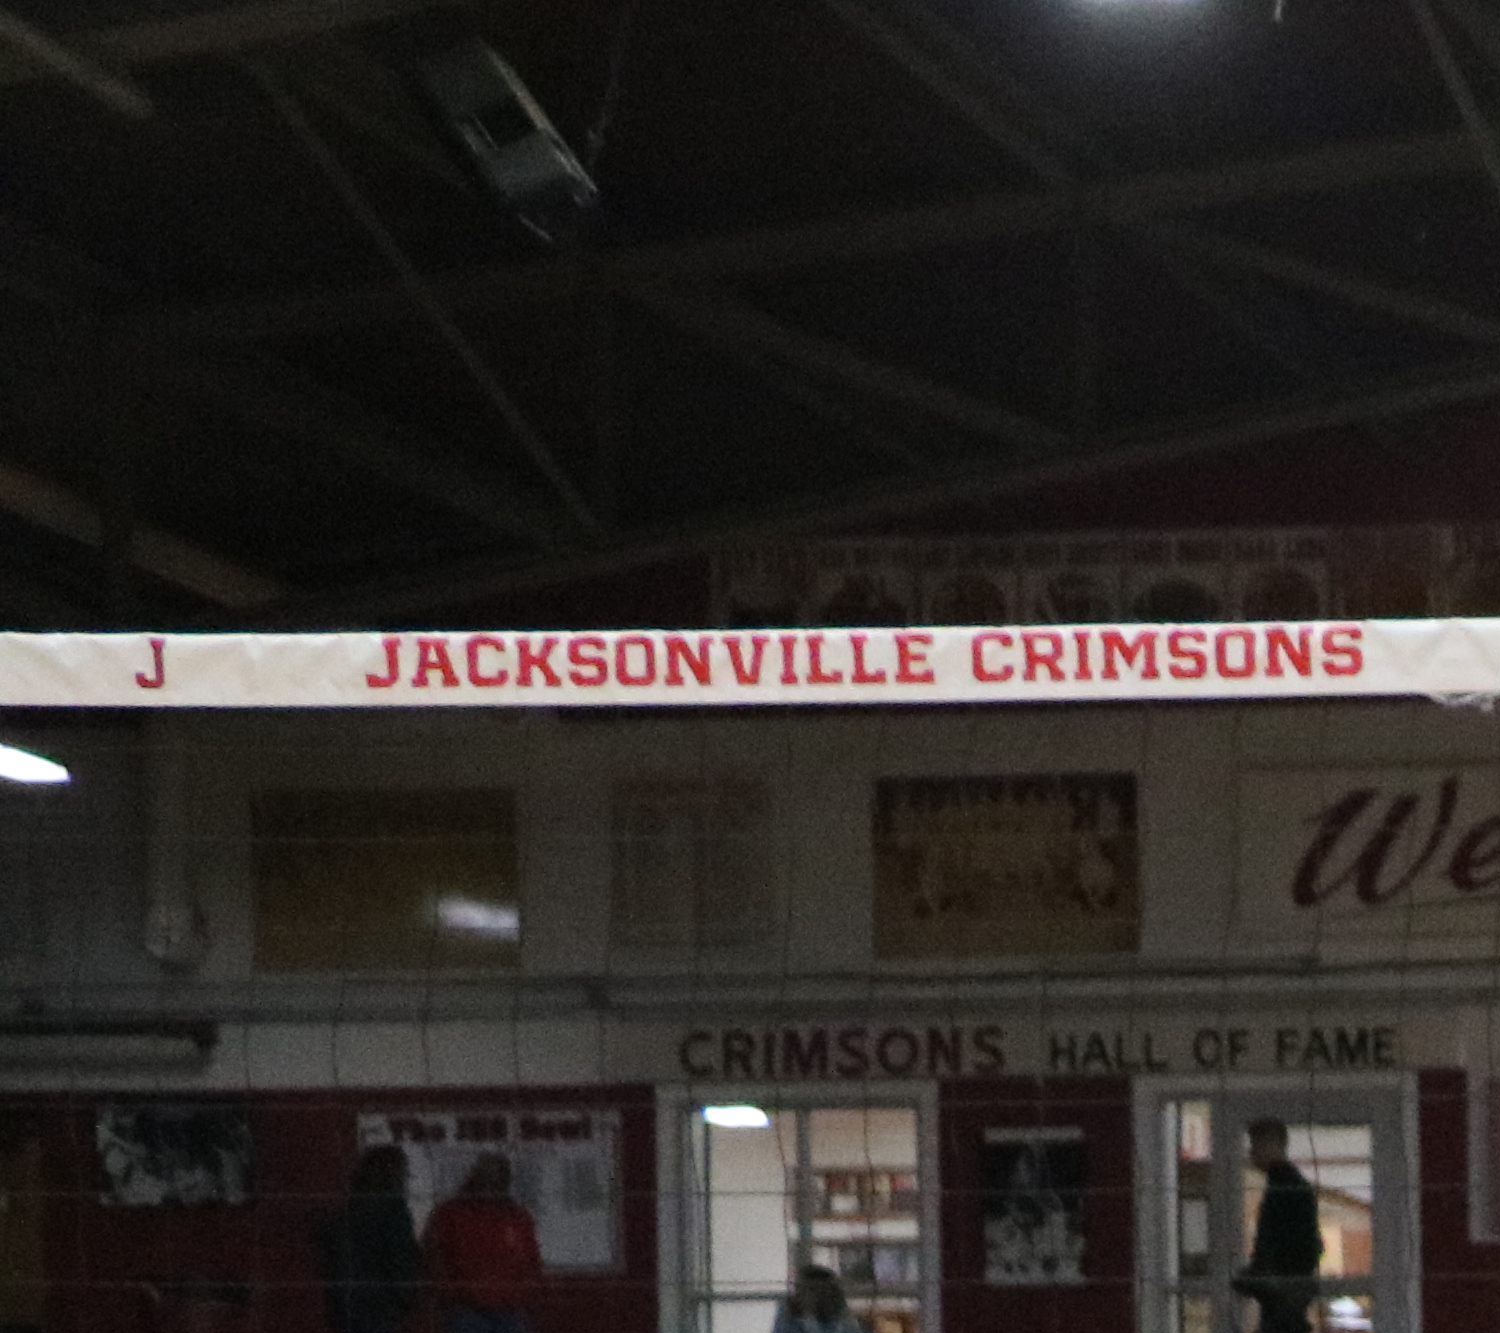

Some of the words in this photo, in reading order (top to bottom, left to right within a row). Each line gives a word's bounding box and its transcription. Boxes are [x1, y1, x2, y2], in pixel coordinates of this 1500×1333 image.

[134, 637, 166, 689] J
[364, 631, 937, 690] JACKSONVILLE
[969, 624, 1365, 684] CRIMSONS
[680, 1025, 1006, 1080] CRIMSONS
[1049, 1033, 1167, 1074] HALL
[1193, 1028, 1249, 1071] OF
[1276, 1026, 1398, 1069] FAME
